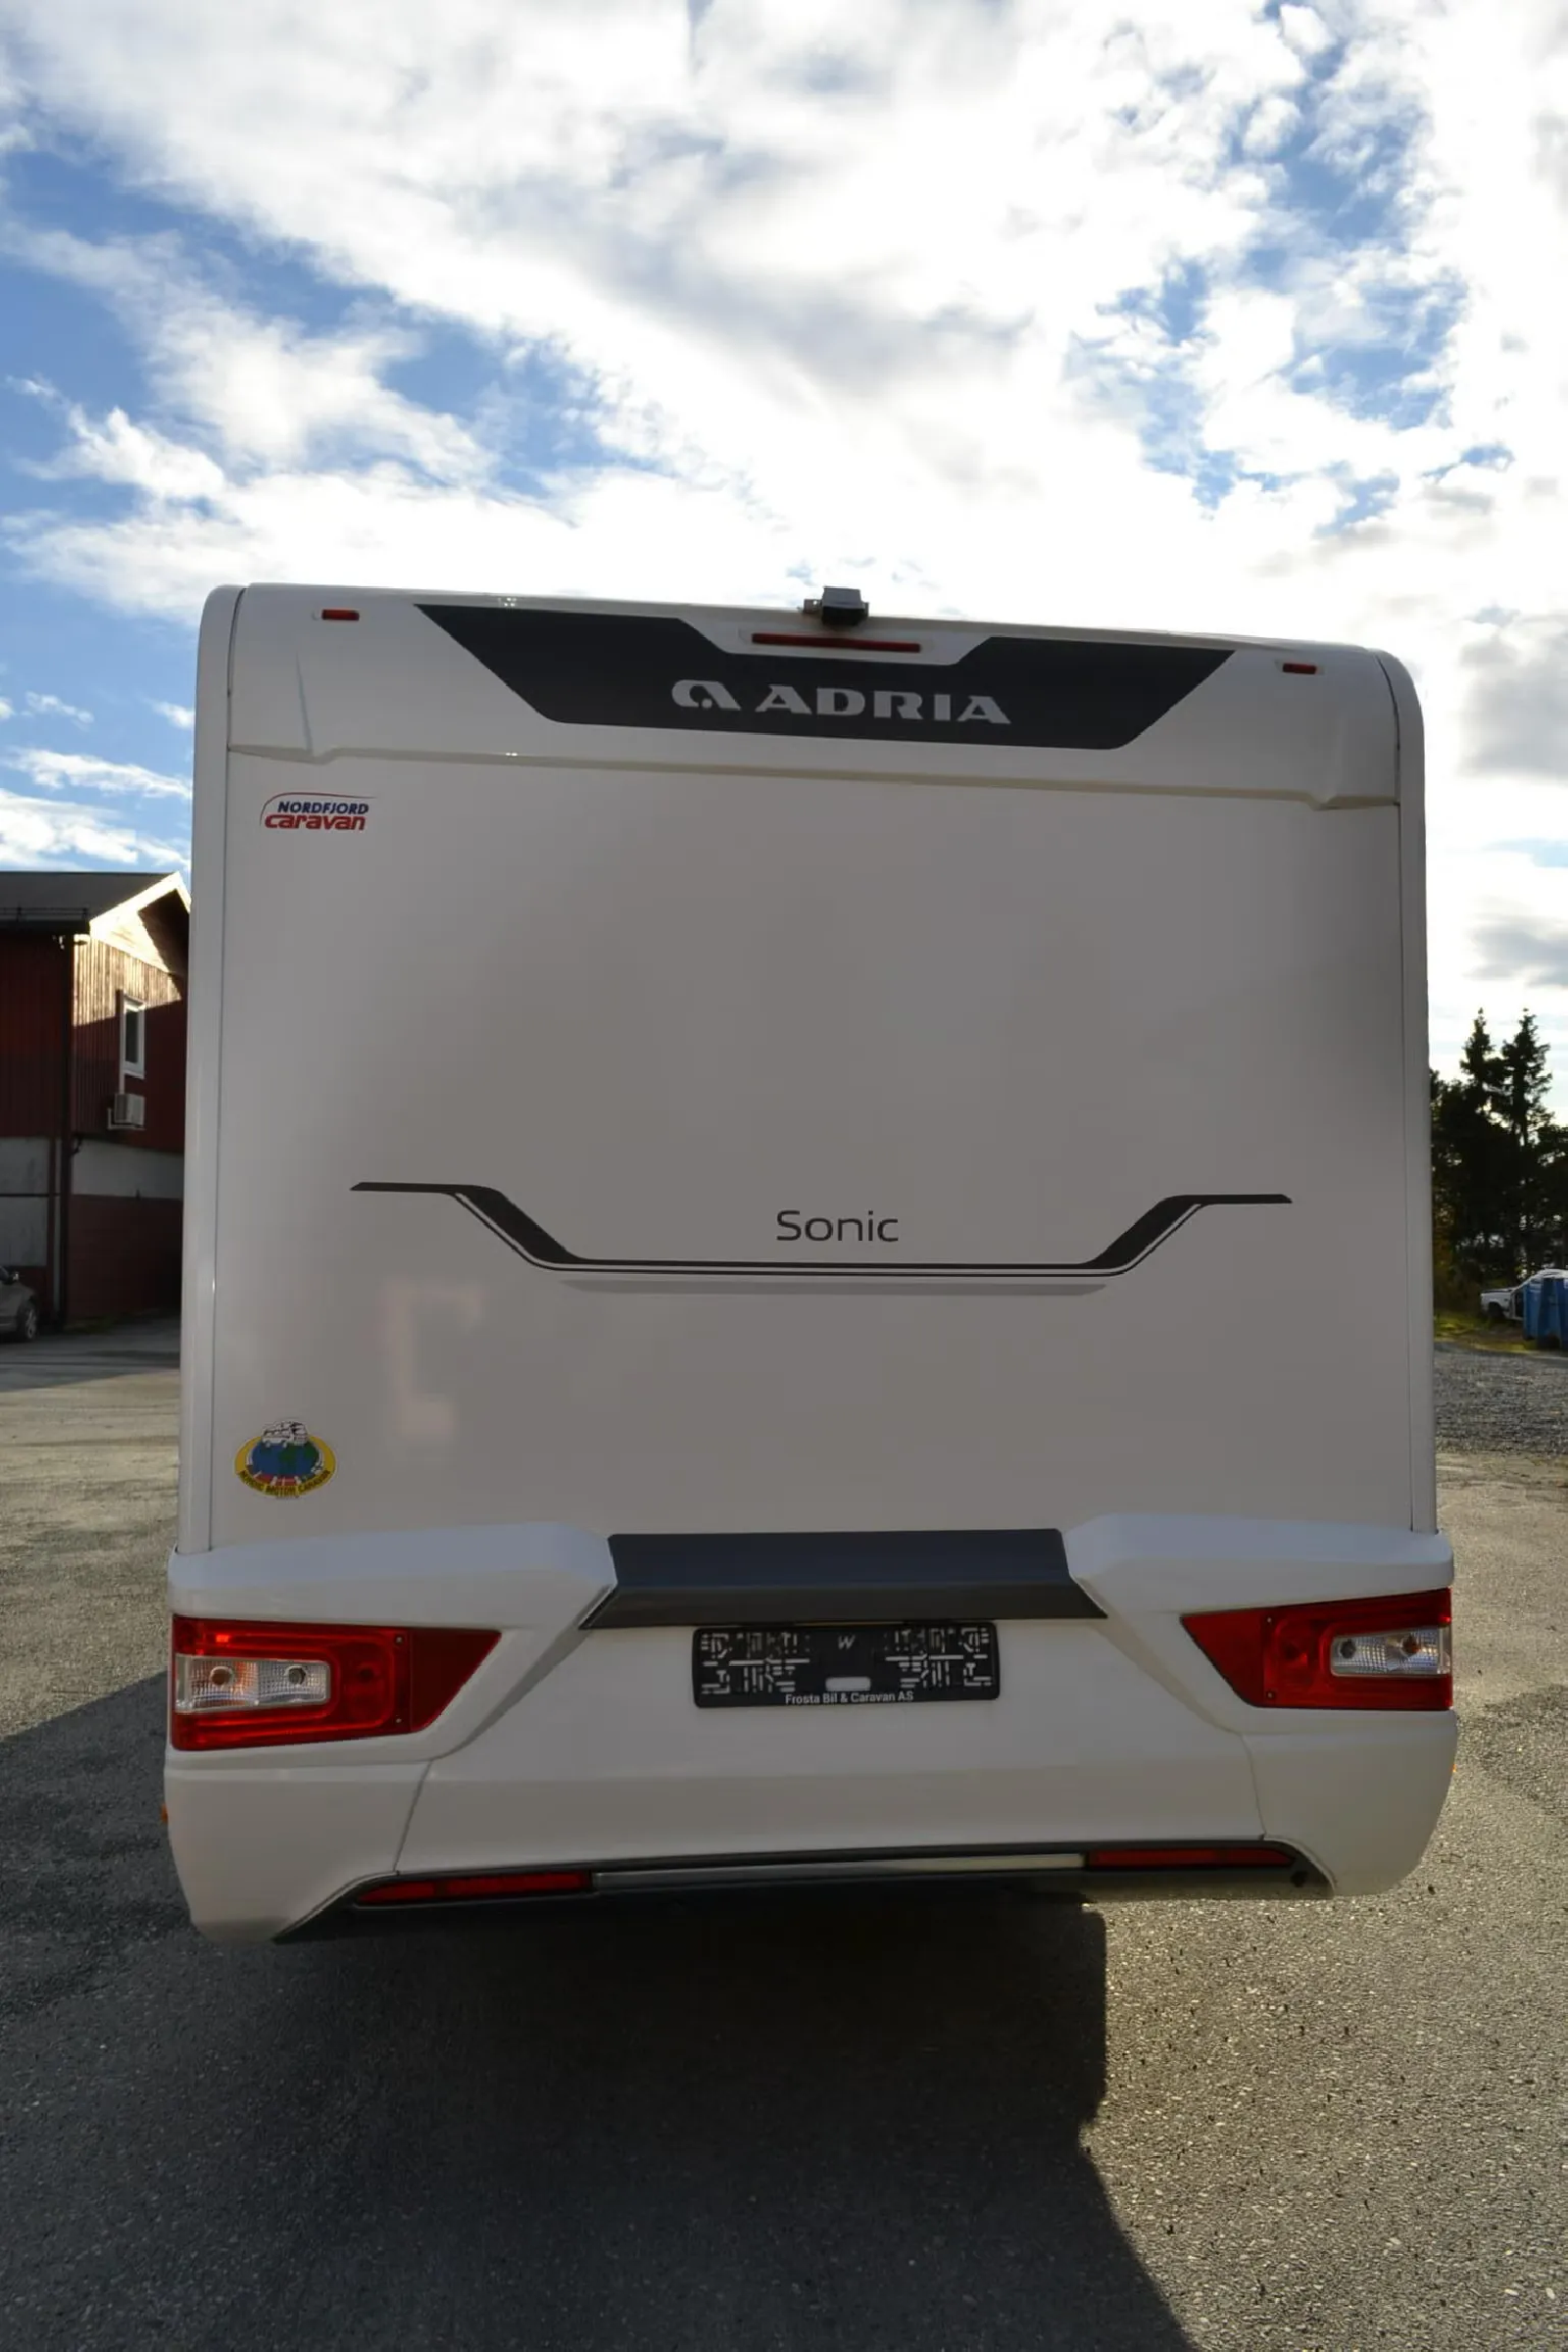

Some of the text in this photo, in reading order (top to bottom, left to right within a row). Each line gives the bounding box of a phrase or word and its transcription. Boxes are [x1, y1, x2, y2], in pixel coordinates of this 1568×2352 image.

[755, 683, 1011, 725] ADRIA
[277, 801, 369, 814] NORDFJORD
[265, 814, 366, 830] caravan
[776, 1209, 899, 1242] Sonic
[840, 1692, 848, 1703] &
[851, 1691, 896, 1703] Caravan
